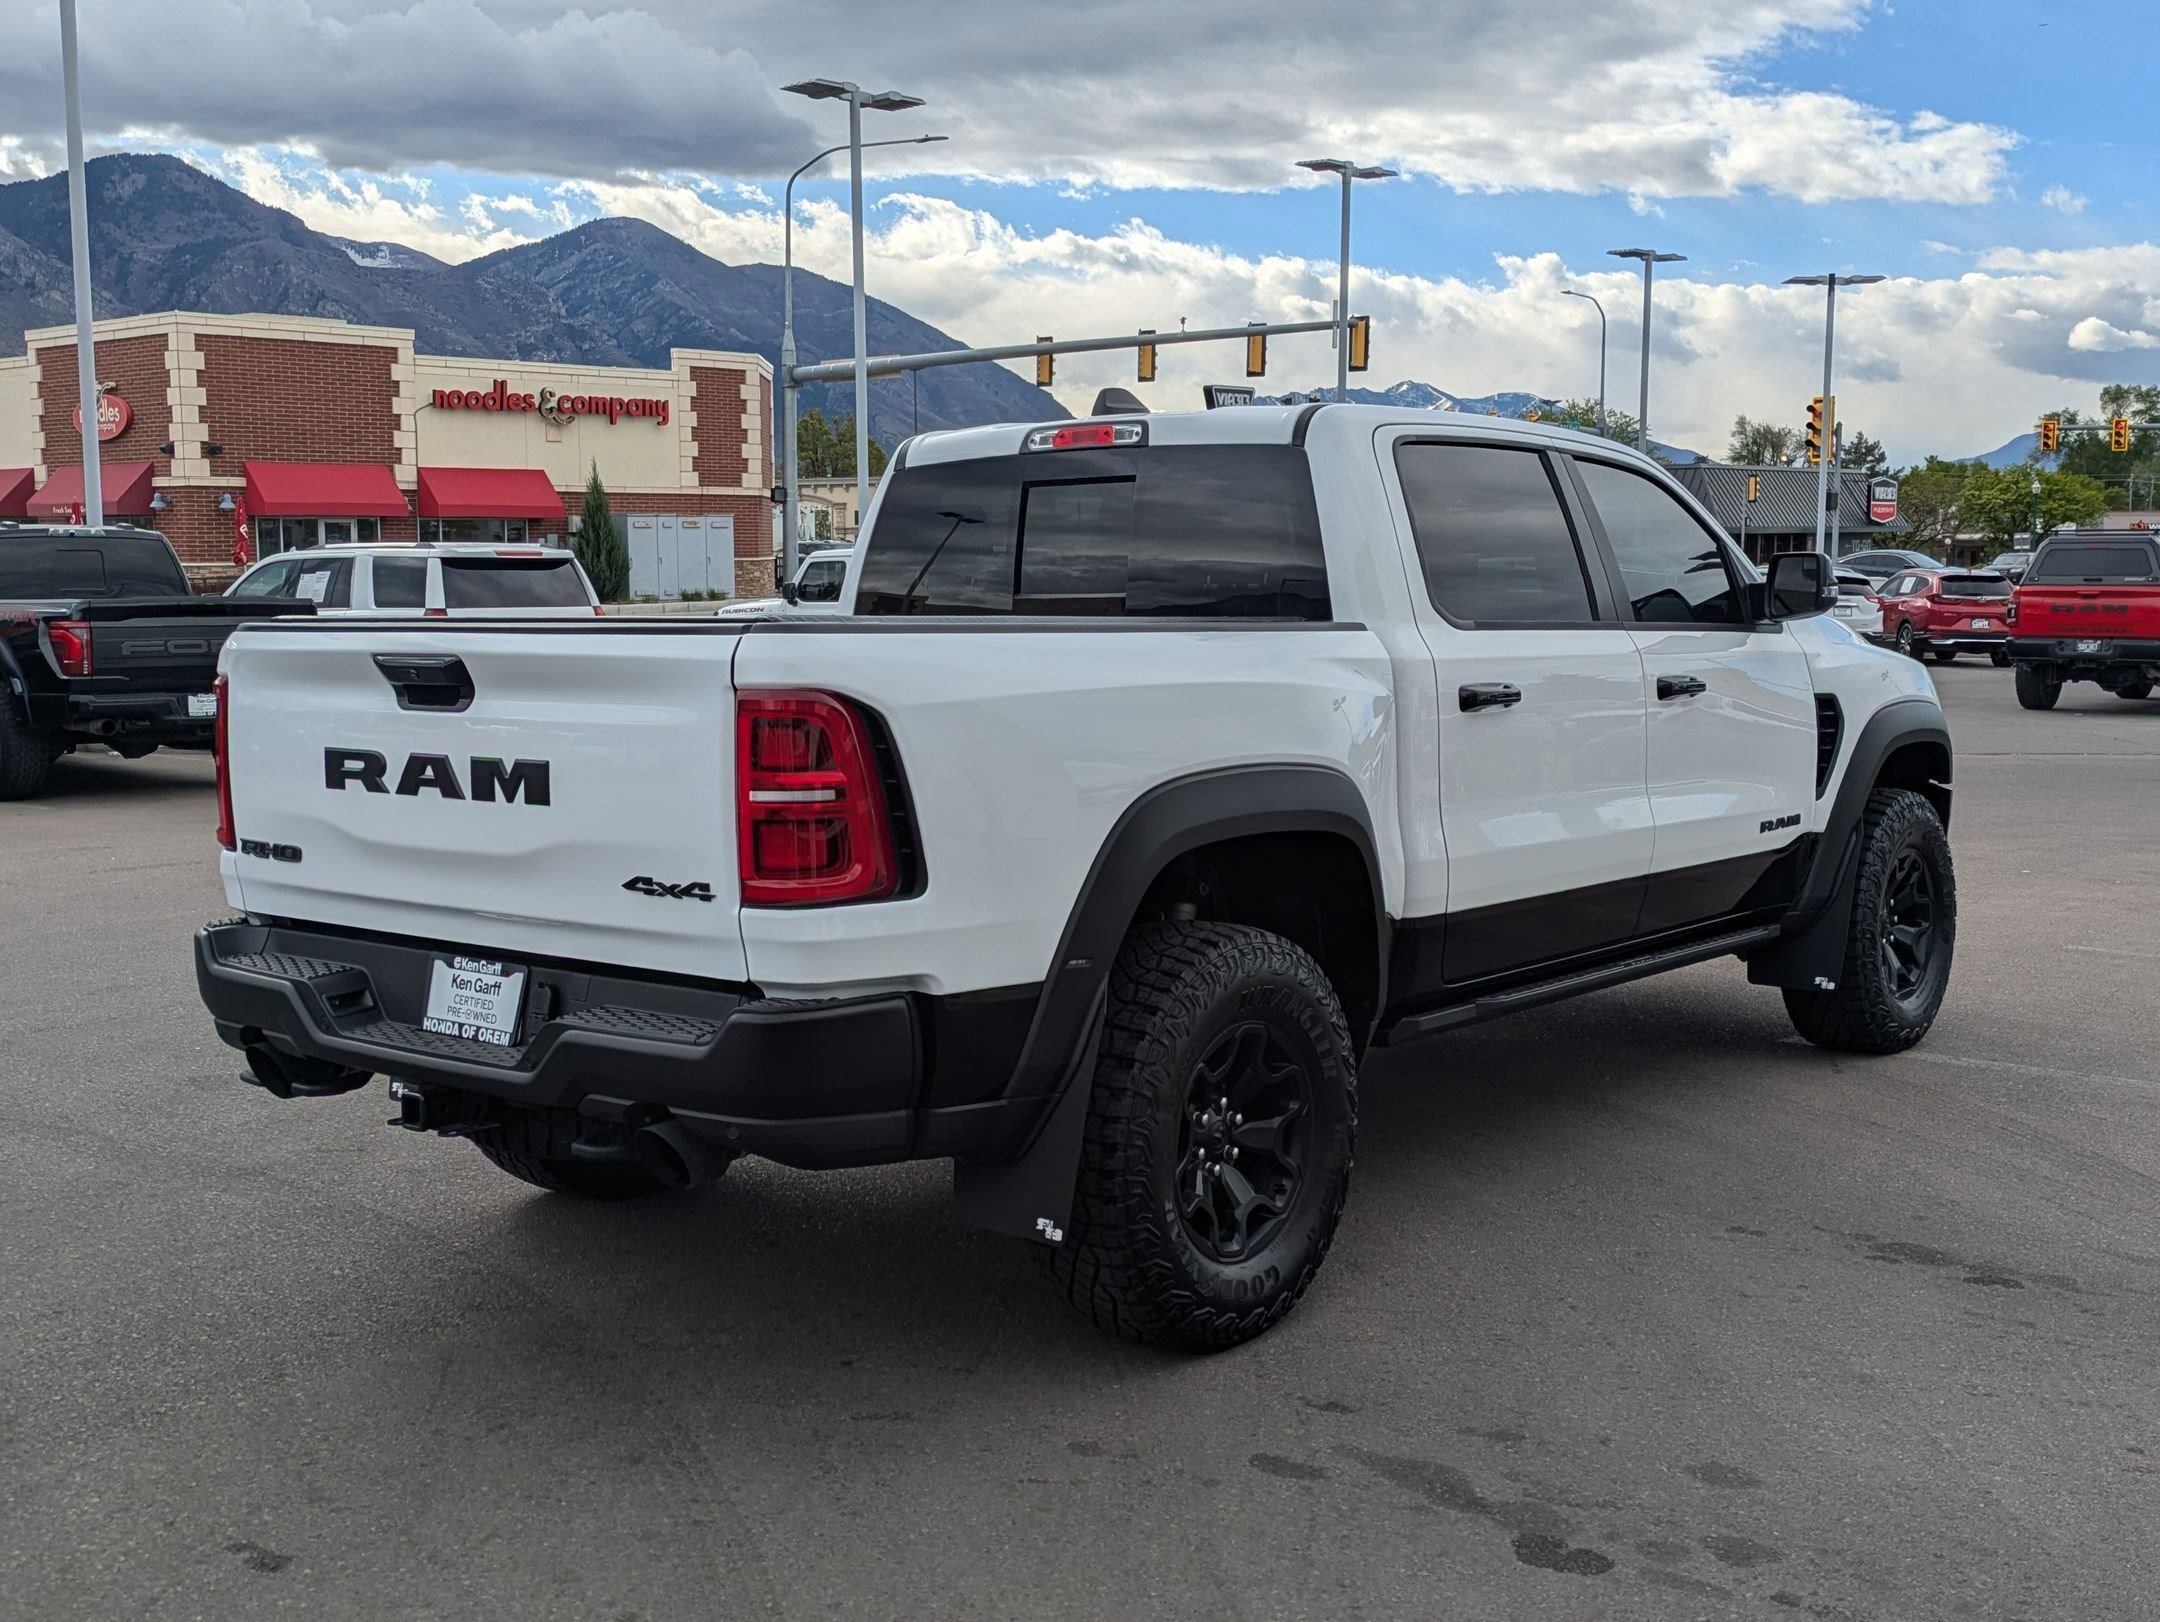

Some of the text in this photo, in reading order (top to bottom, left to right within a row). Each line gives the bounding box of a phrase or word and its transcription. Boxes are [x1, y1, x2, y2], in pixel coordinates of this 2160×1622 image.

[432, 379, 535, 412] noodles
[557, 394, 669, 426] company
[721, 607, 765, 615] RUBICON
[2051, 604, 2129, 613] RAM
[324, 747, 551, 806] RAM
[1759, 813, 1801, 834] RAM
[240, 838, 303, 863] RHO
[621, 875, 717, 902] 4x4
[461, 957, 503, 975] Ken Garff
[451, 973, 502, 997] Ken Garff
[453, 994, 494, 1010] CERTIFIED
[423, 1017, 510, 1046] HONDA OF OREM
